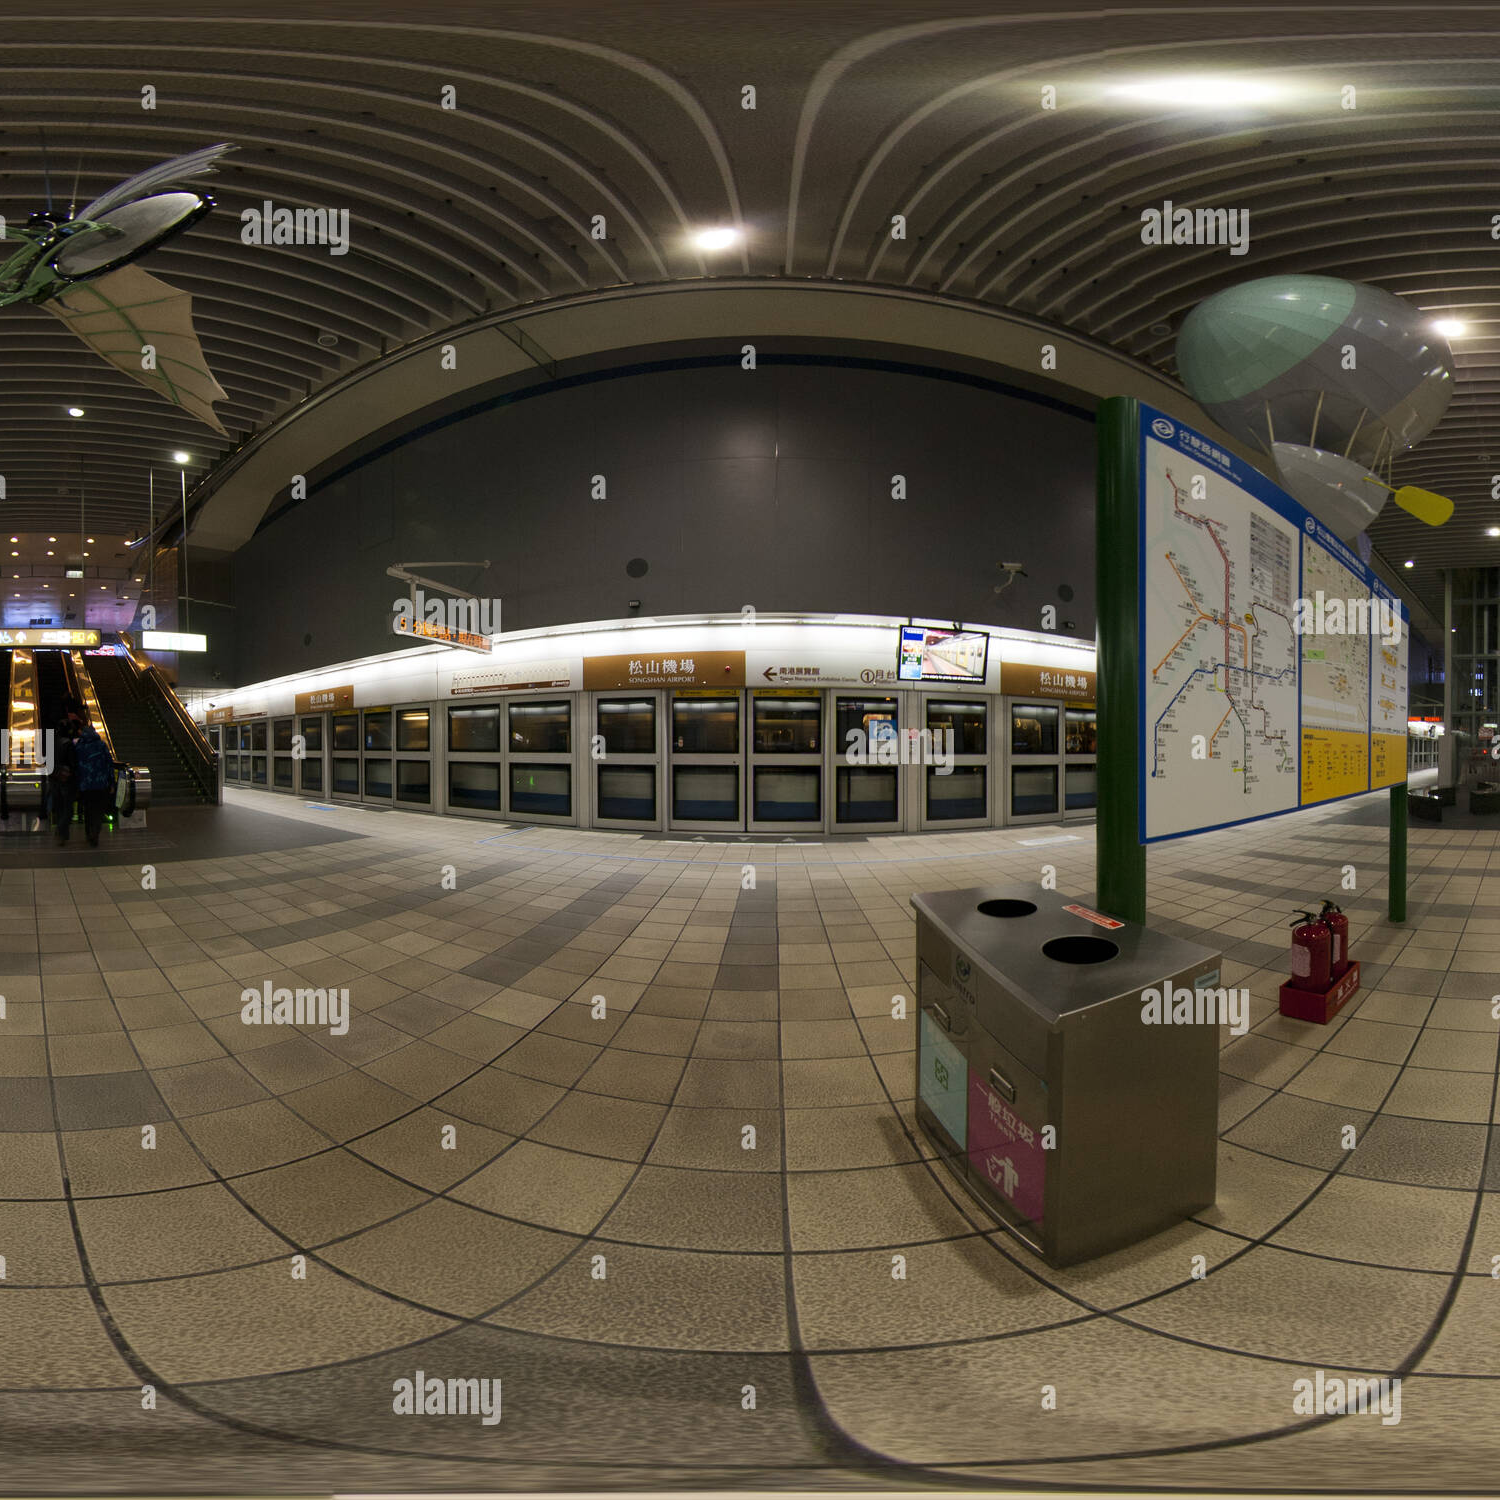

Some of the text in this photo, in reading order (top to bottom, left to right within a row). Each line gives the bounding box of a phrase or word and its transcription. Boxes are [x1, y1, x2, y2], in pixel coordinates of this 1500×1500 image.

[629, 659, 695, 675] 松山機場
[1040, 672, 1088, 690] 松山機場
[975, 1082, 1035, 1149] 一般垃圾
